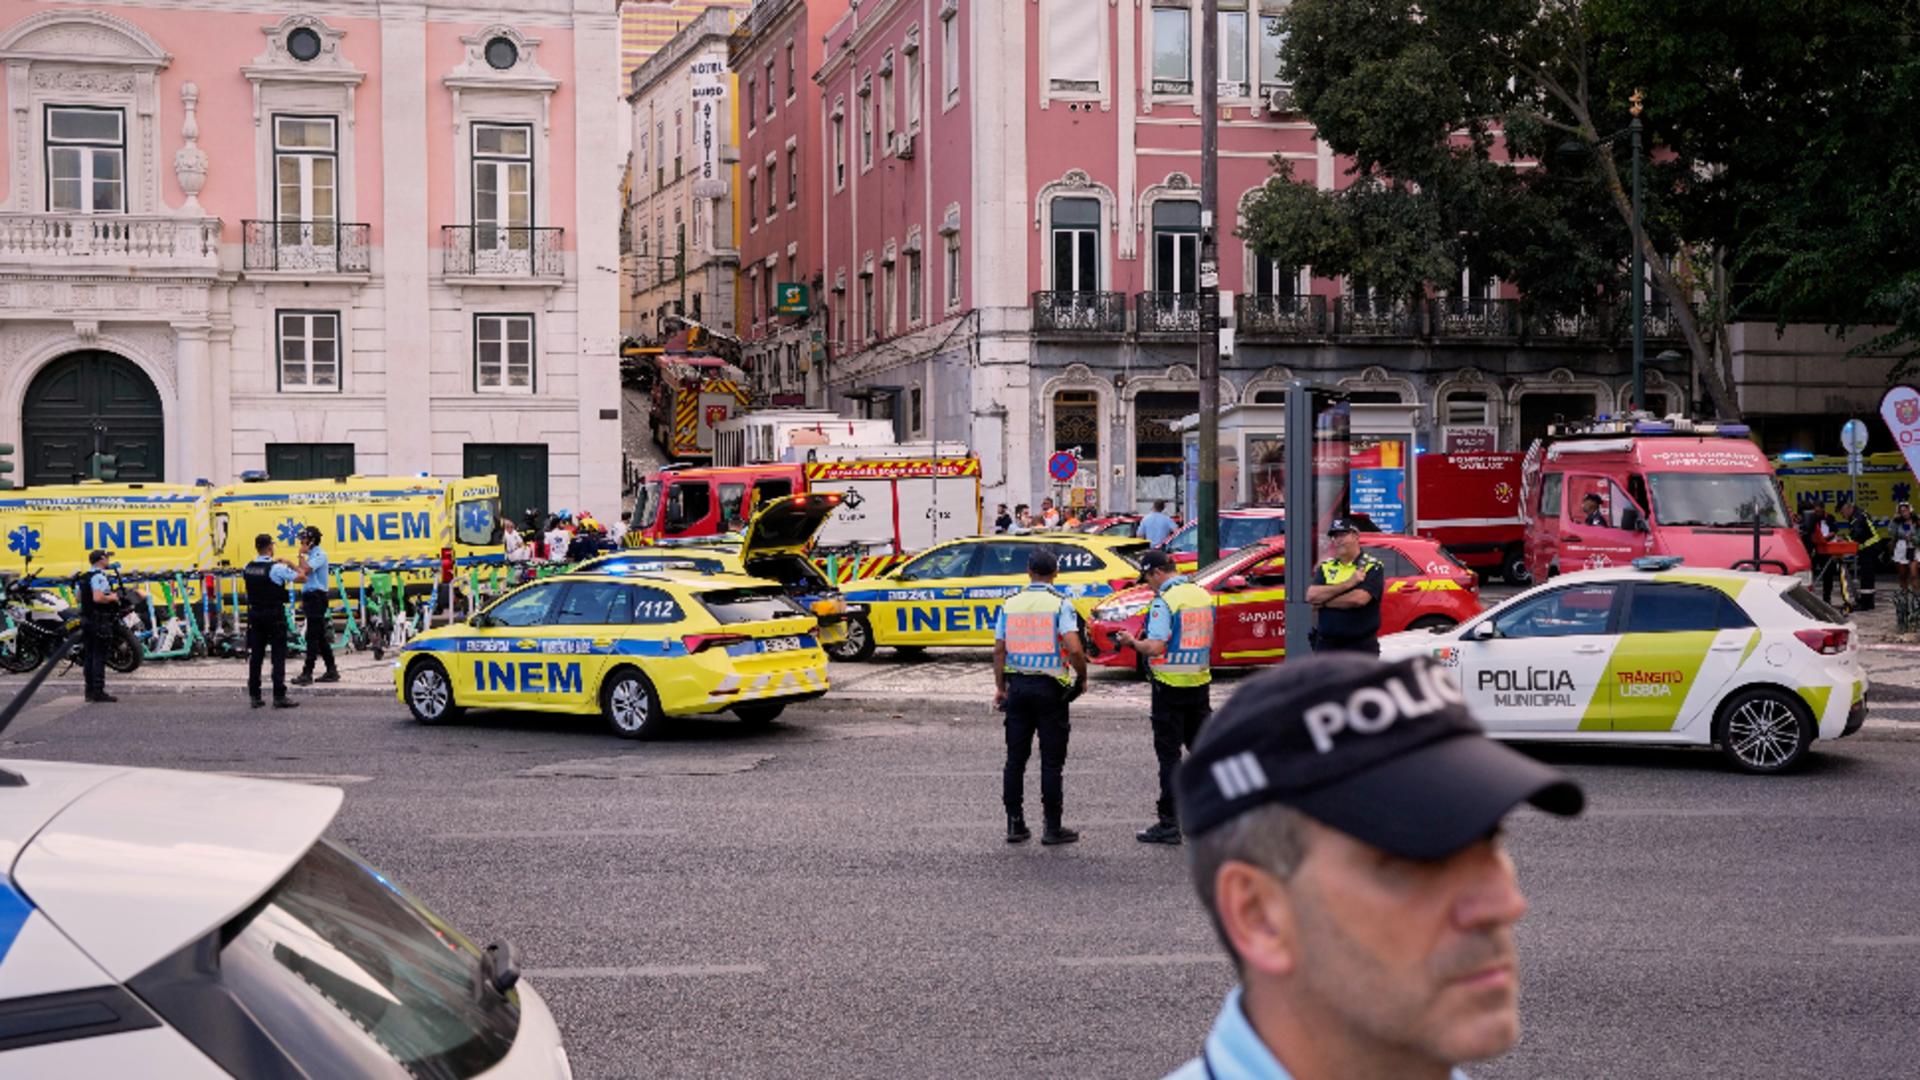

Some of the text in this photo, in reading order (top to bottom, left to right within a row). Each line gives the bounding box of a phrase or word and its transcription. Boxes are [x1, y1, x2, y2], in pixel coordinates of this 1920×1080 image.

[691, 62, 724, 74] HOTEL
[84, 518, 189, 551] INEM
[336, 511, 432, 543] INEM
[1064, 552, 1093, 567] 112
[643, 600, 674, 618] 112
[474, 660, 583, 694] INEM
[1477, 666, 1576, 692] POLÍCIA
[1617, 669, 1684, 684] TRÂNSITO
[1620, 684, 1672, 697] LISBOA
[1494, 694, 1577, 707] MUNICIPAL
